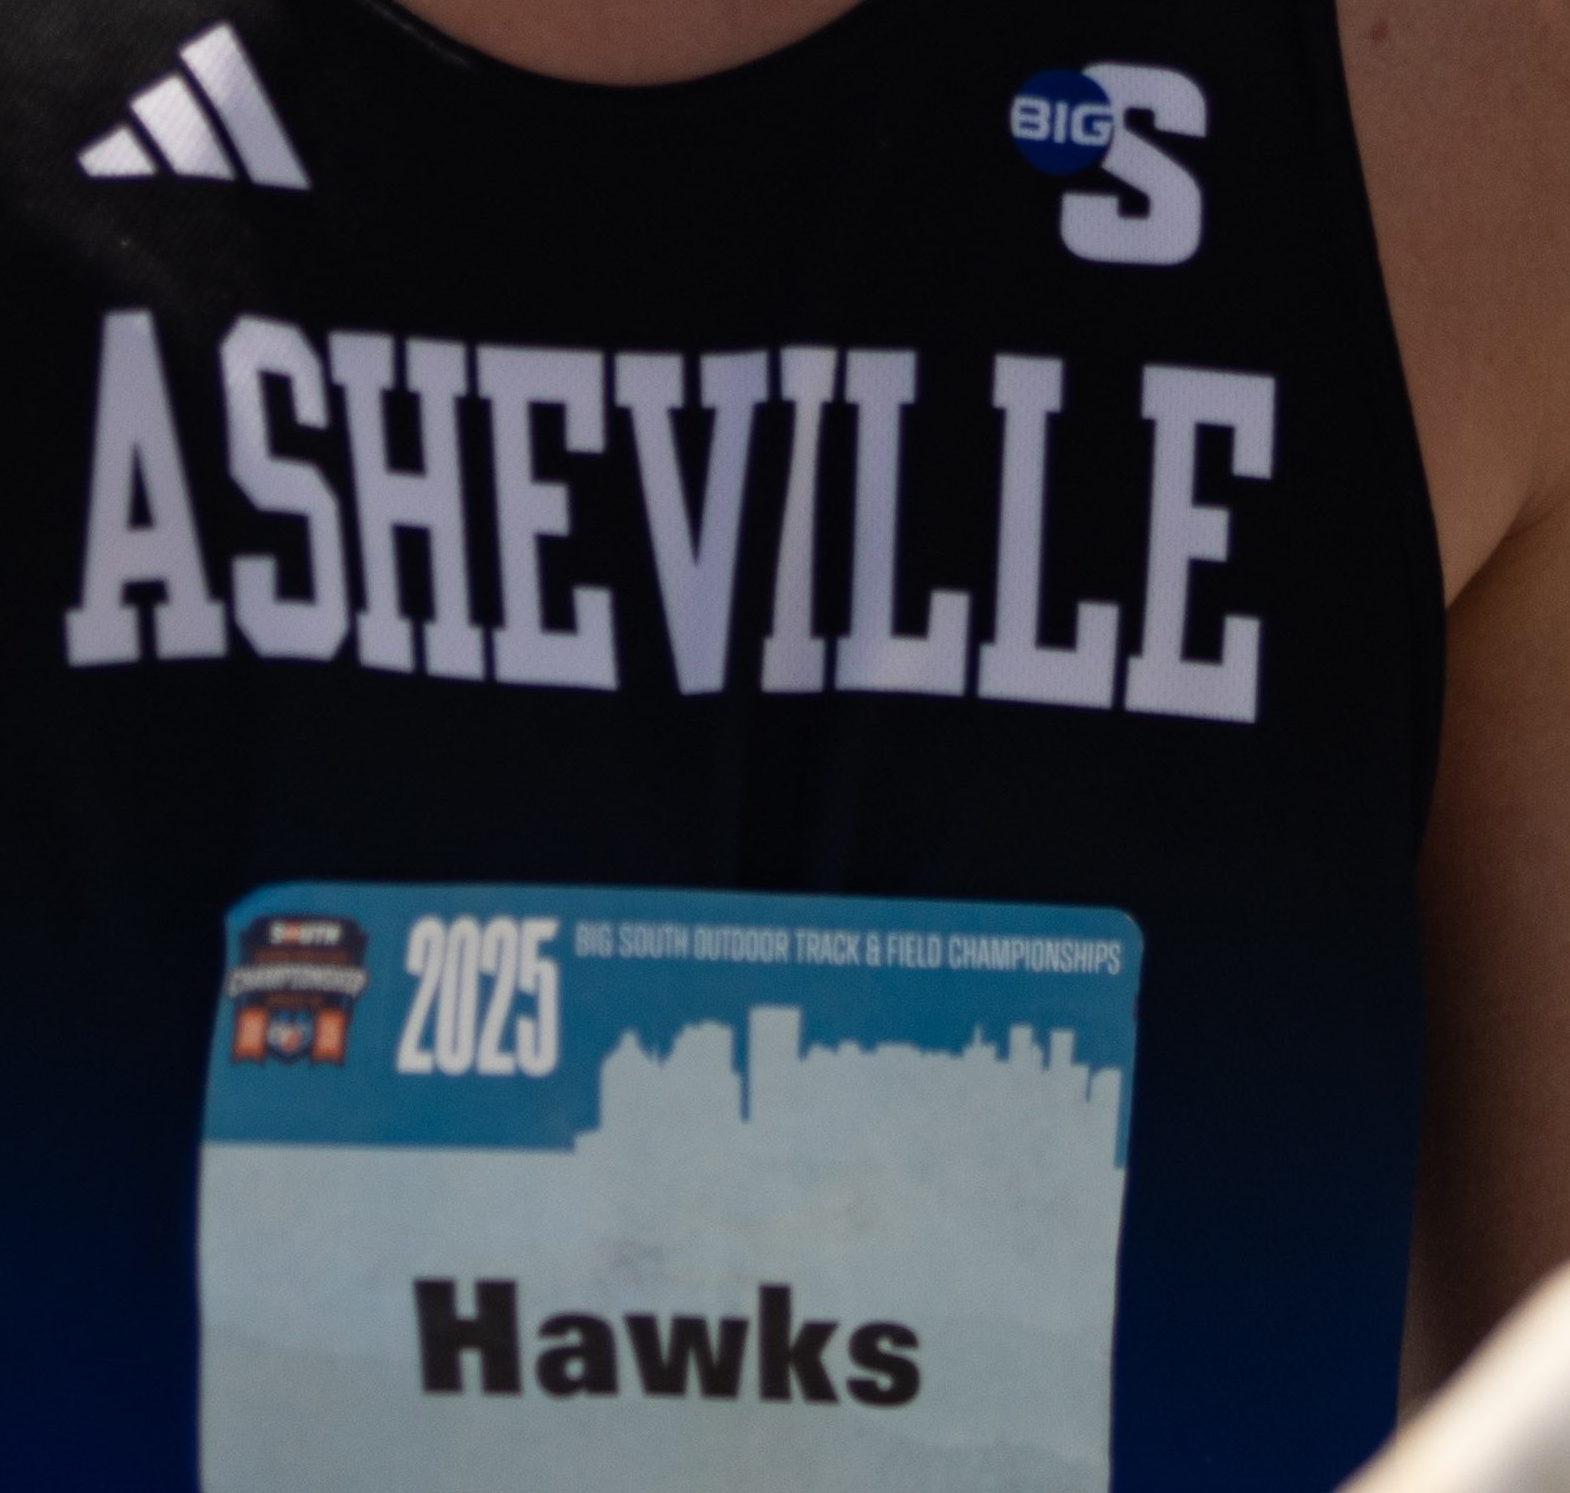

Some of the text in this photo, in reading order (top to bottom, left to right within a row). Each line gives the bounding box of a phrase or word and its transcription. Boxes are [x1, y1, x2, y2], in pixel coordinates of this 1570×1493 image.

[1011, 63, 1207, 265] BIG S
[65, 309, 1276, 724] ASHEVILLE
[395, 915, 561, 1079] 2025
[574, 921, 1122, 977] BIG SOUTH OUTDOOR TRACK & FIELD CHAMPIONSHIPS
[413, 1277, 922, 1408] Hawks
